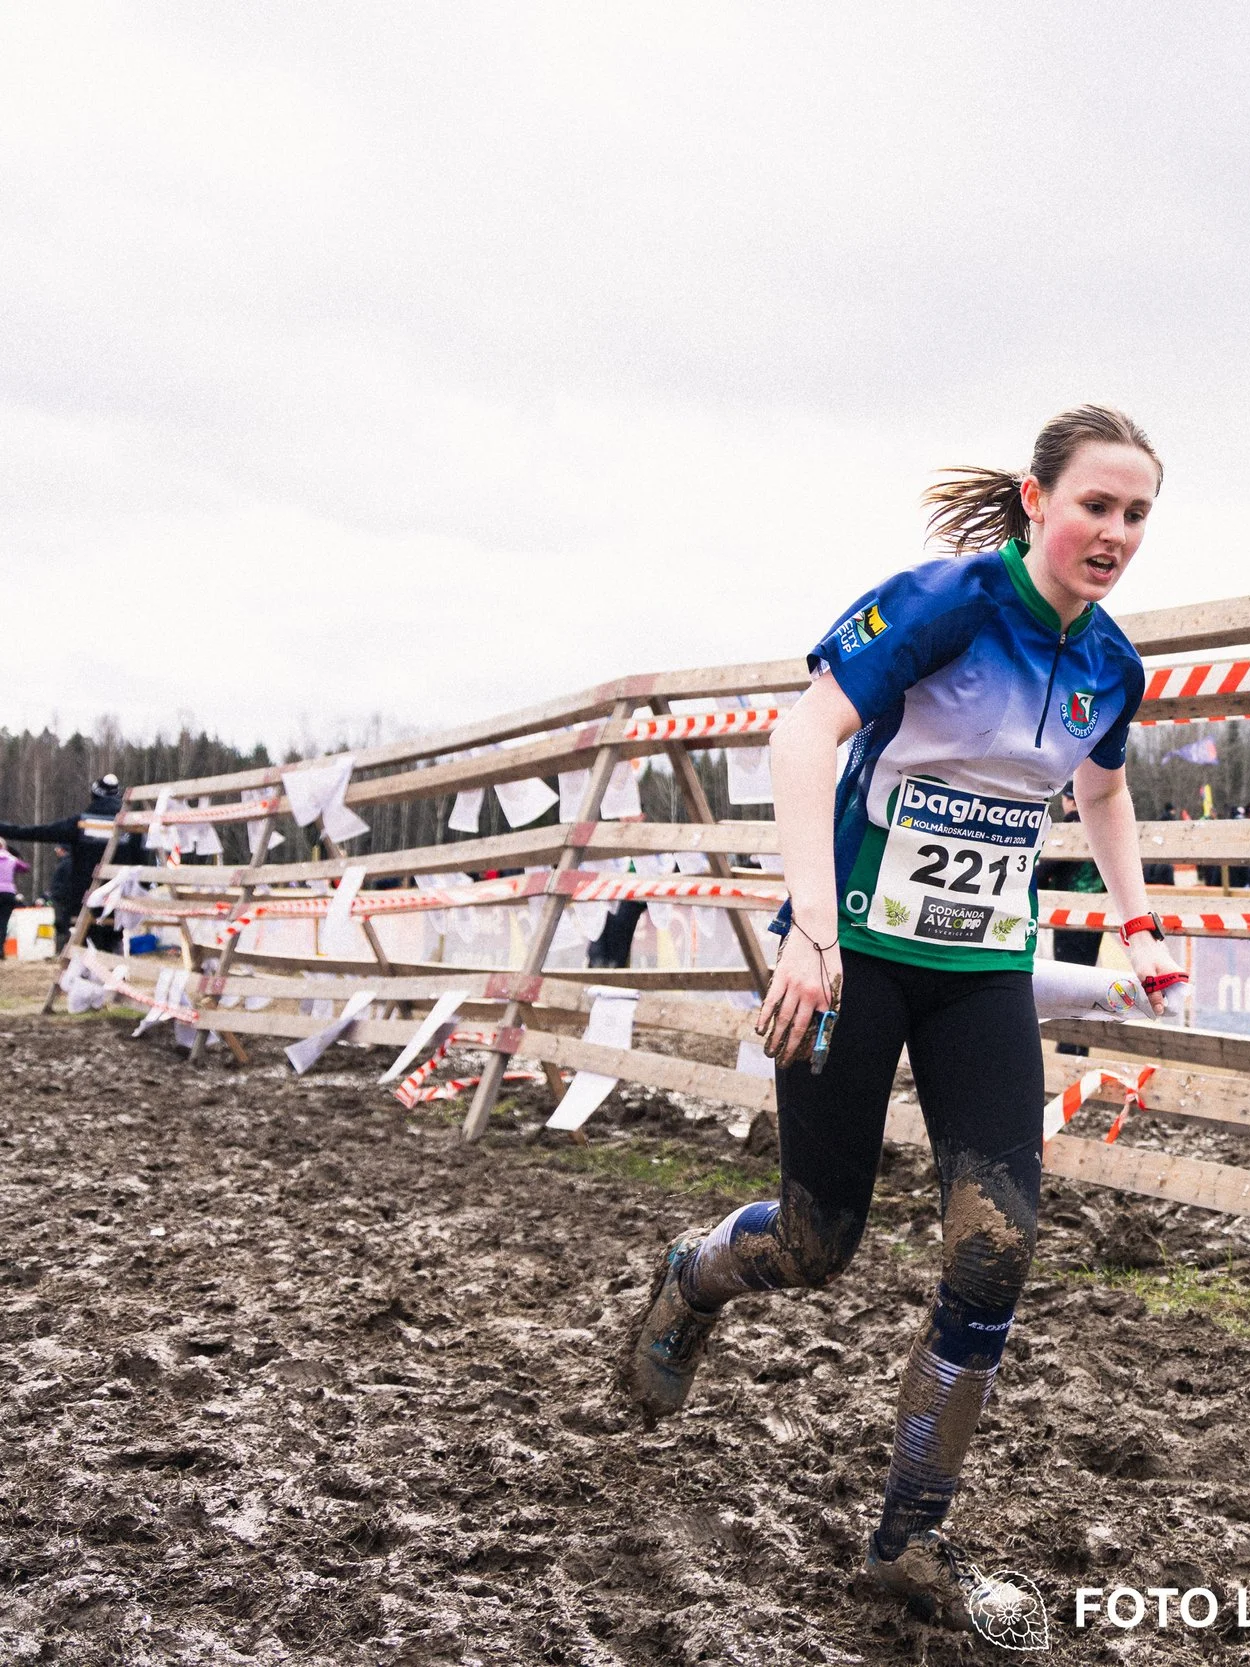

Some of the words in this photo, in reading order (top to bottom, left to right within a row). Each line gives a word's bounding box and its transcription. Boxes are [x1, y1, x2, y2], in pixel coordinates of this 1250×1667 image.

[837, 625, 852, 653] CUP
[845, 620, 861, 649] CITY
[1061, 704, 1069, 720] OK
[903, 783, 1044, 829] bagheera
[913, 819, 985, 839] KOLMÅRDSKAVLEN
[990, 834, 1003, 843] STL
[1012, 836, 1027, 845] 2026
[909, 844, 1010, 896] 221
[1016, 854, 1027, 872] 3
[928, 903, 985, 919] GODKÄNDA
